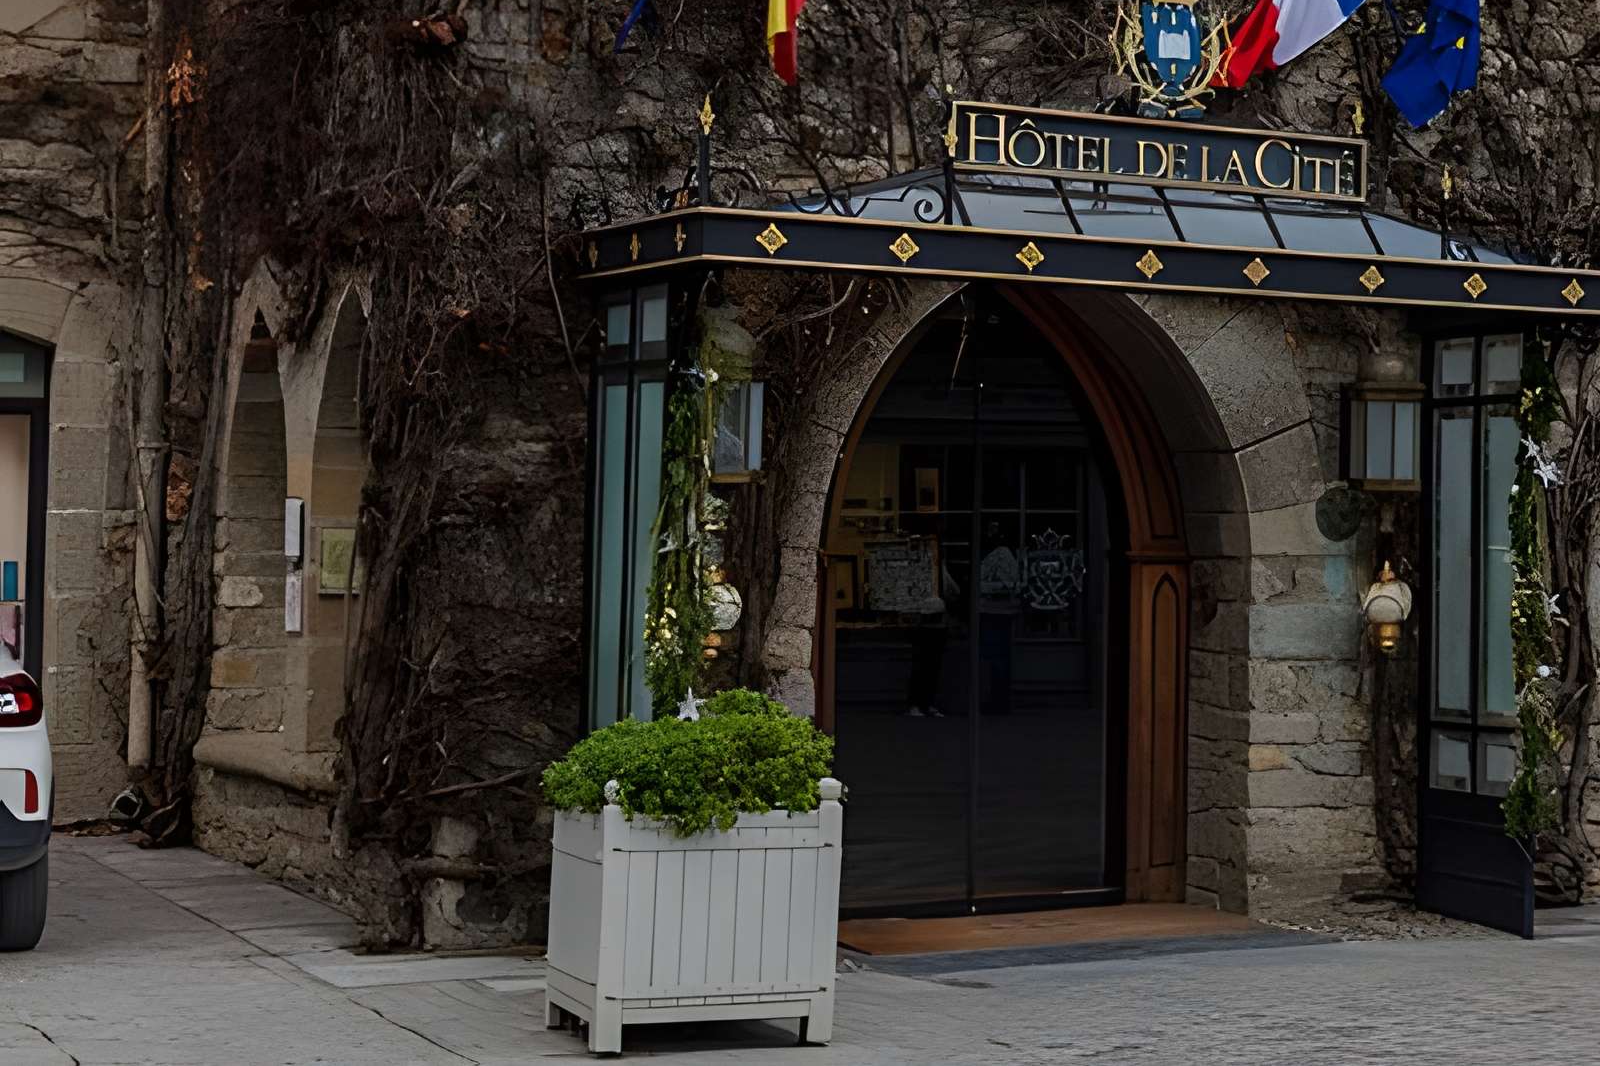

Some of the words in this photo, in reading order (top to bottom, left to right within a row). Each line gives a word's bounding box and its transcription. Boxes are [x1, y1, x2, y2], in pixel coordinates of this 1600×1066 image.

[966, 112, 1123, 174] HÔTEL
[1136, 140, 1189, 180] DE
[1201, 145, 1250, 188] LA
